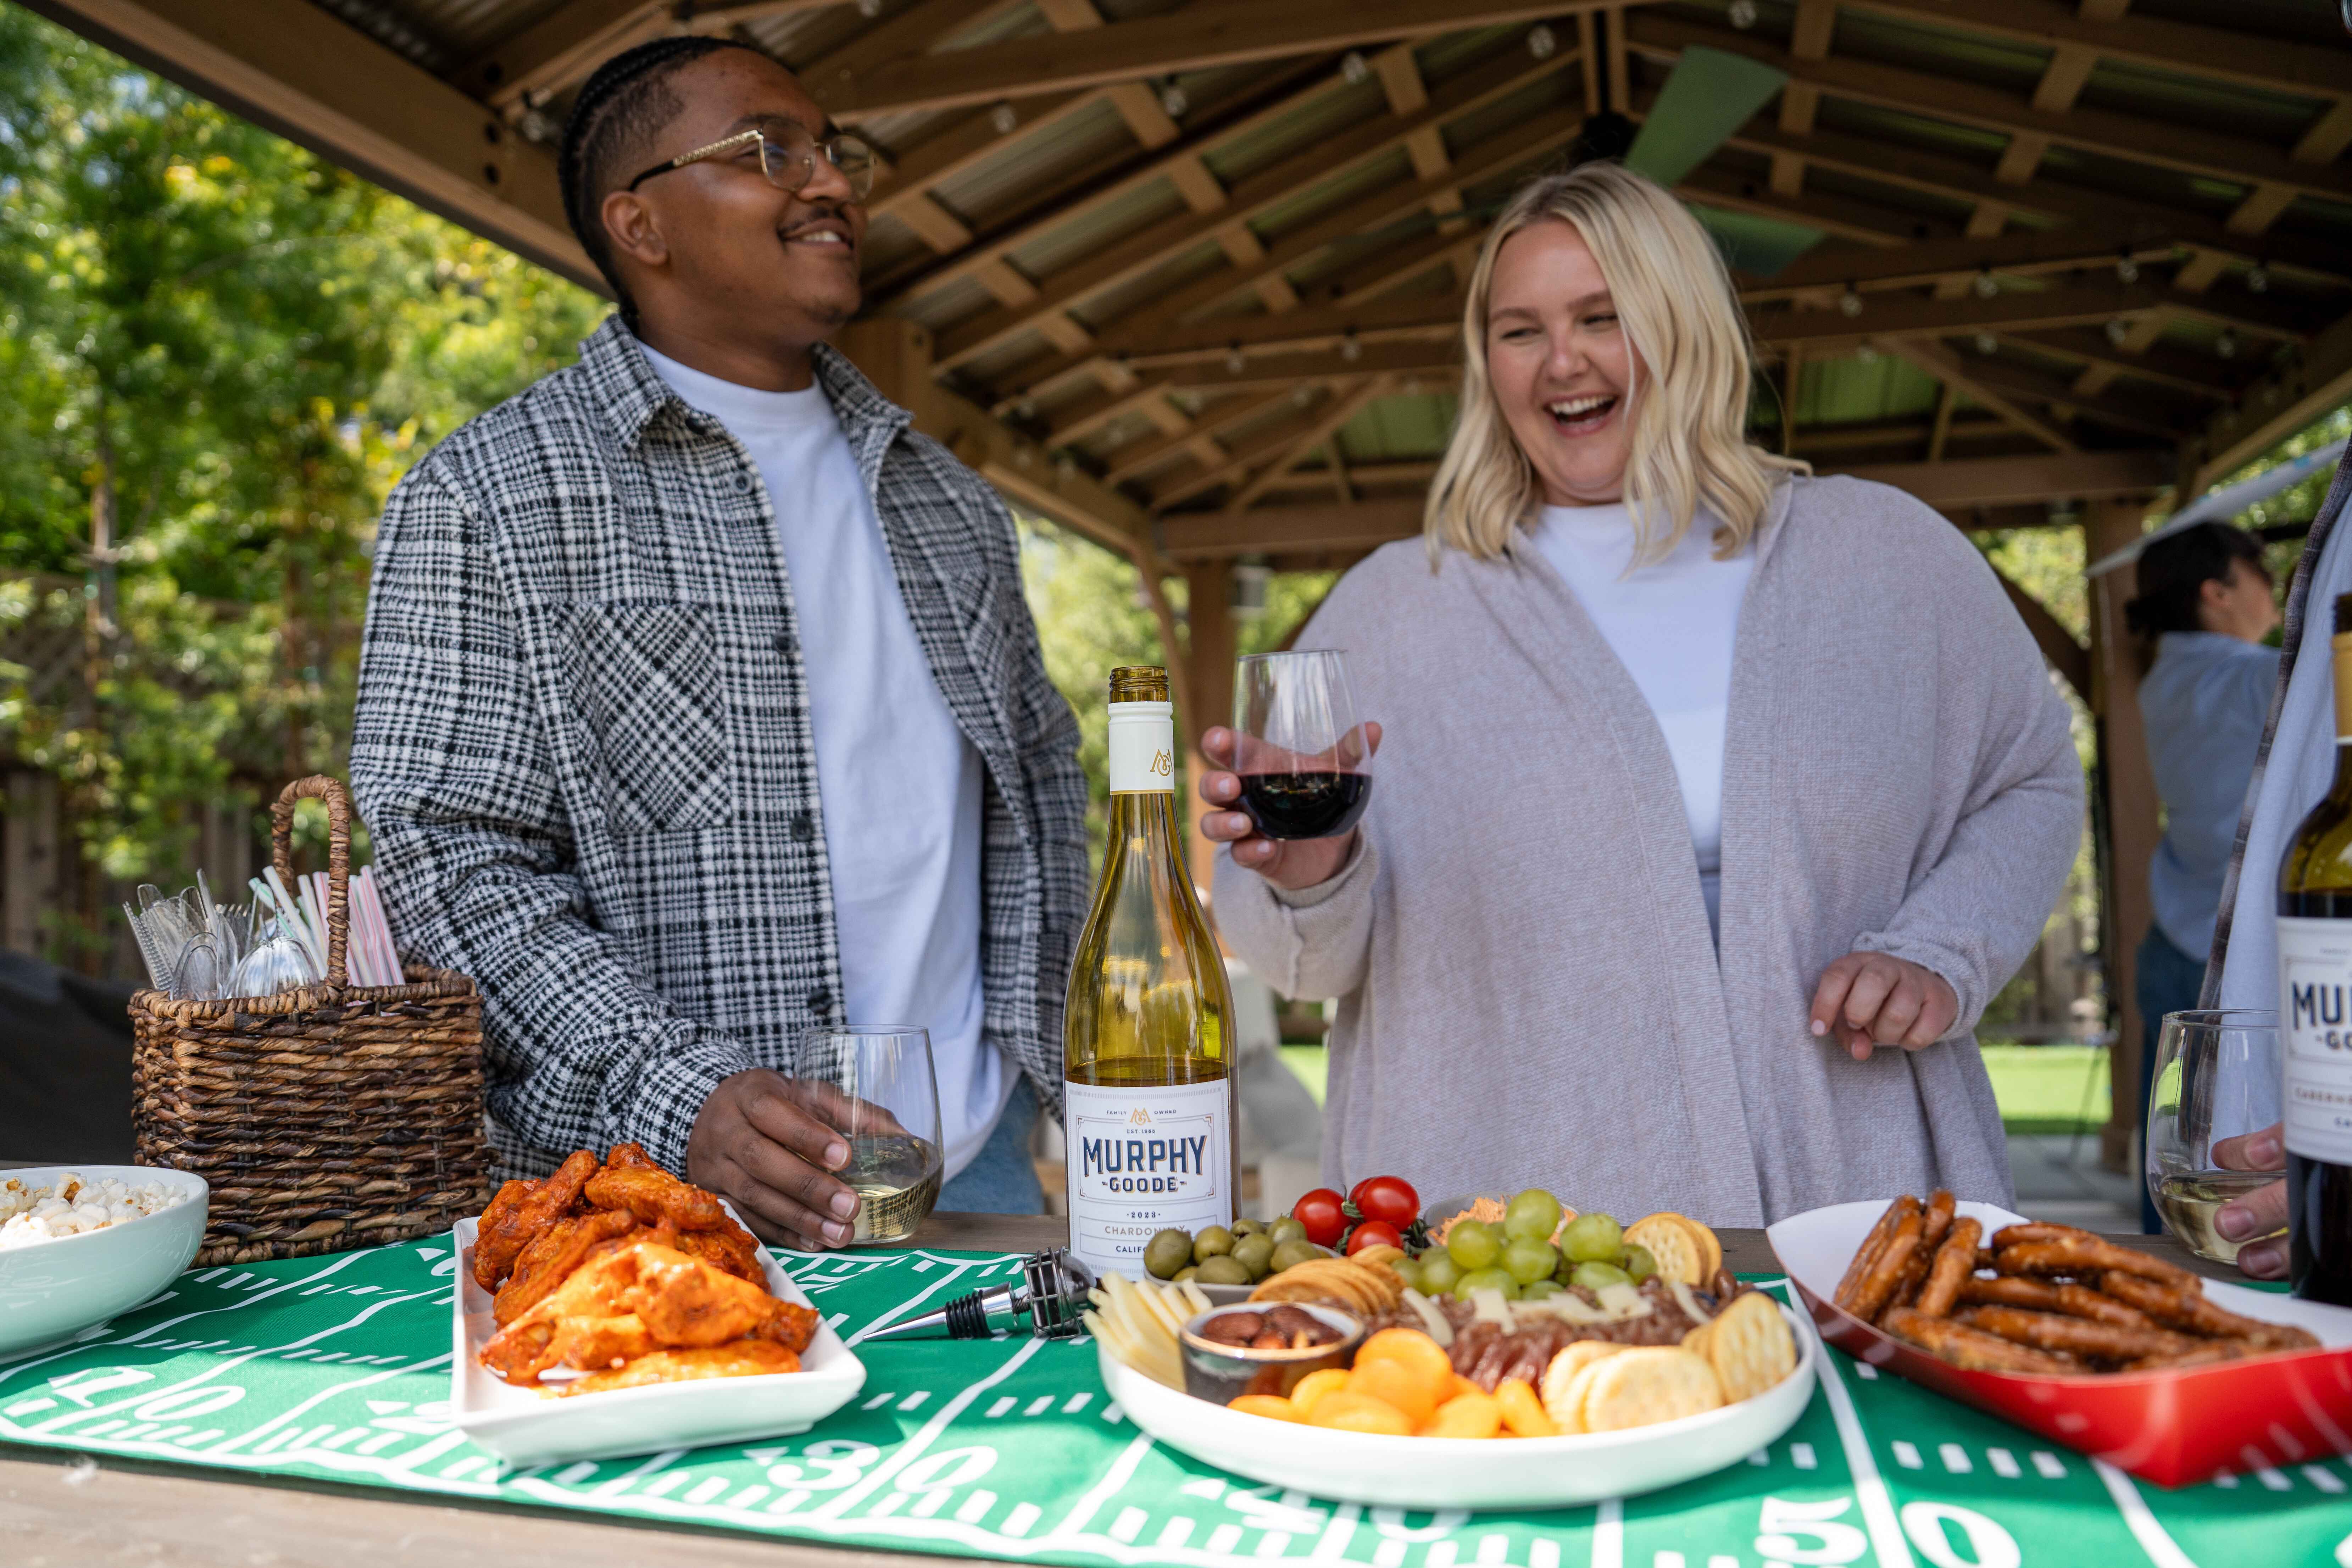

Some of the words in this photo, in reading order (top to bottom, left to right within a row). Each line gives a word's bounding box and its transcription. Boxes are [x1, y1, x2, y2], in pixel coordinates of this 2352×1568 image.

[2292, 980, 2352, 1031] MU
[1083, 1134, 1208, 1178] MURPHY
[1754, 1496, 2022, 1568] 50
